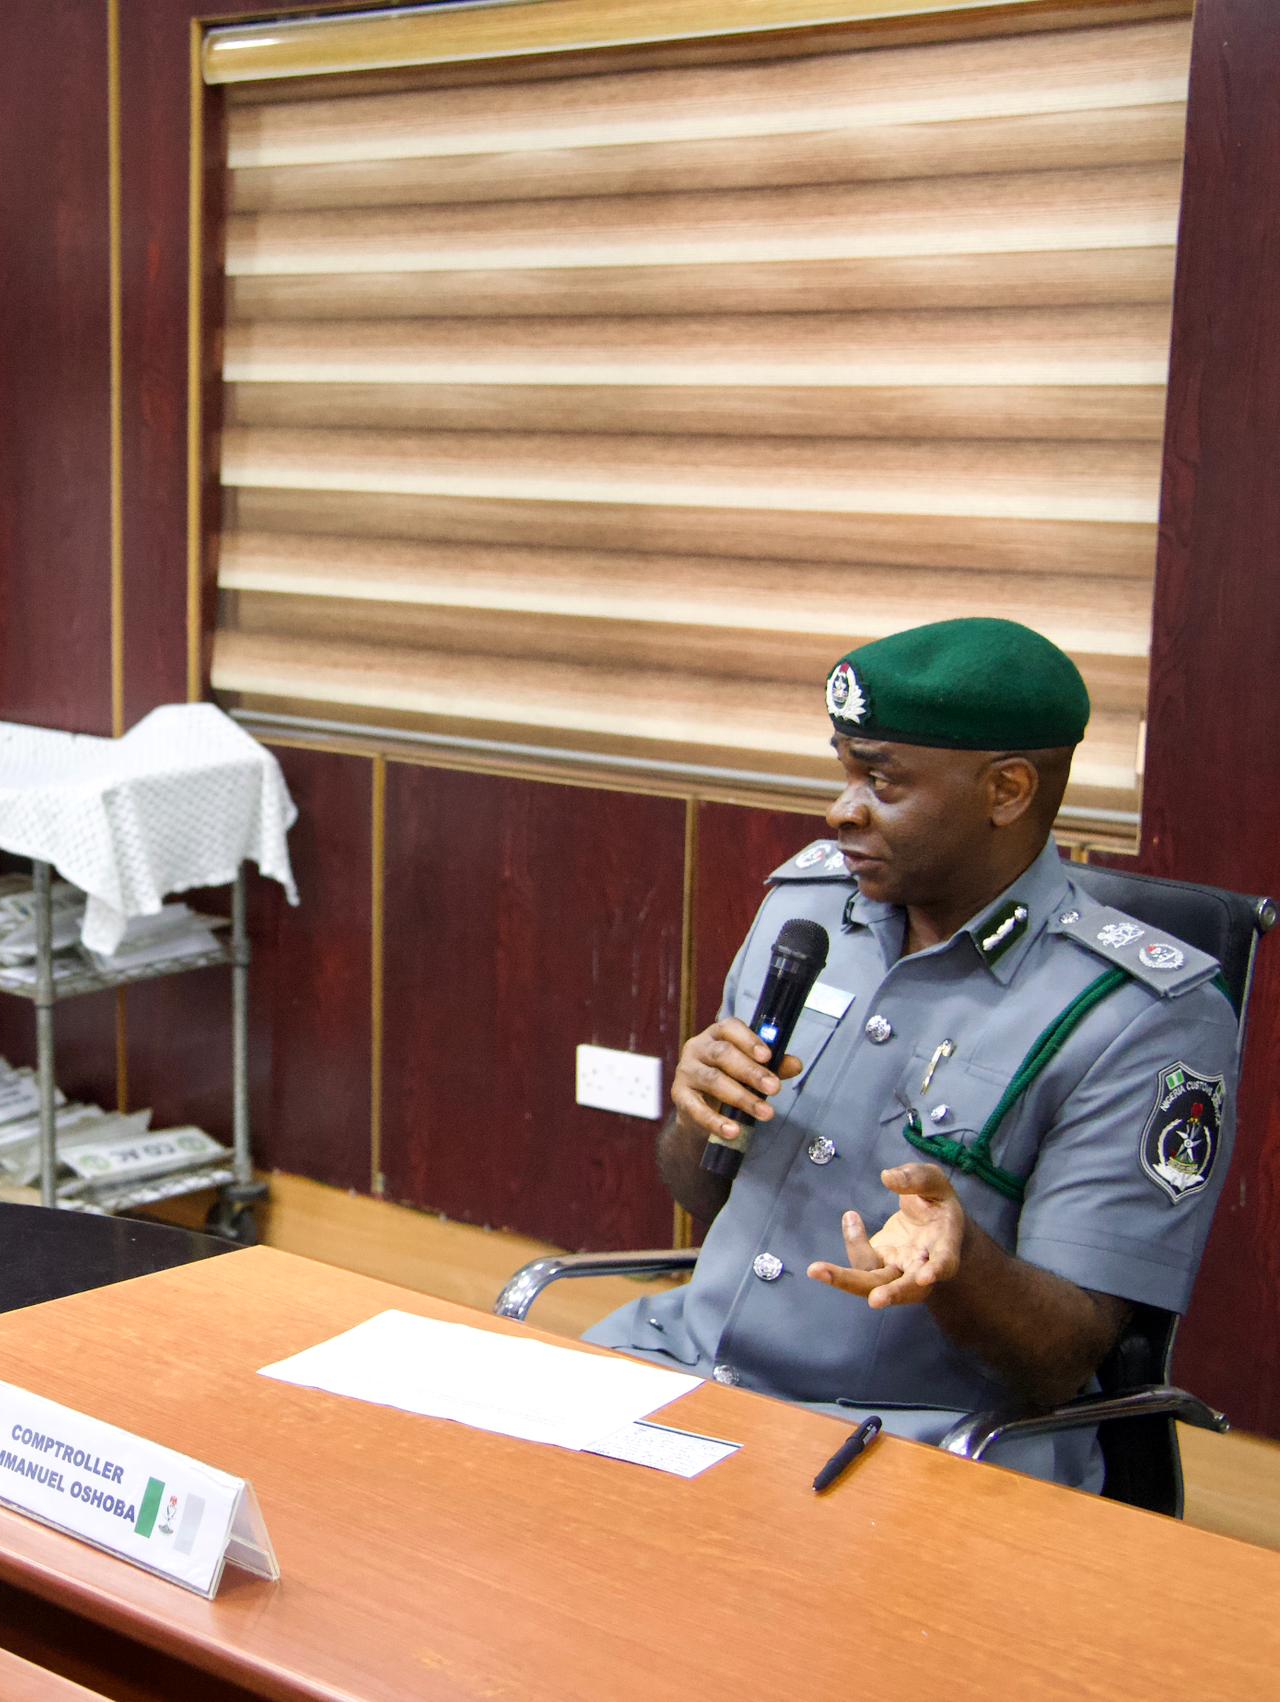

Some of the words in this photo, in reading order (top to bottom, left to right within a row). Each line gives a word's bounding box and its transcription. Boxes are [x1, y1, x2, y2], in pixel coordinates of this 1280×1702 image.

[1160, 1085, 1186, 1112] NIGERIA
[11, 1424, 124, 1485] COMPTROLLER
[70, 1481, 135, 1523] OSHOBA
